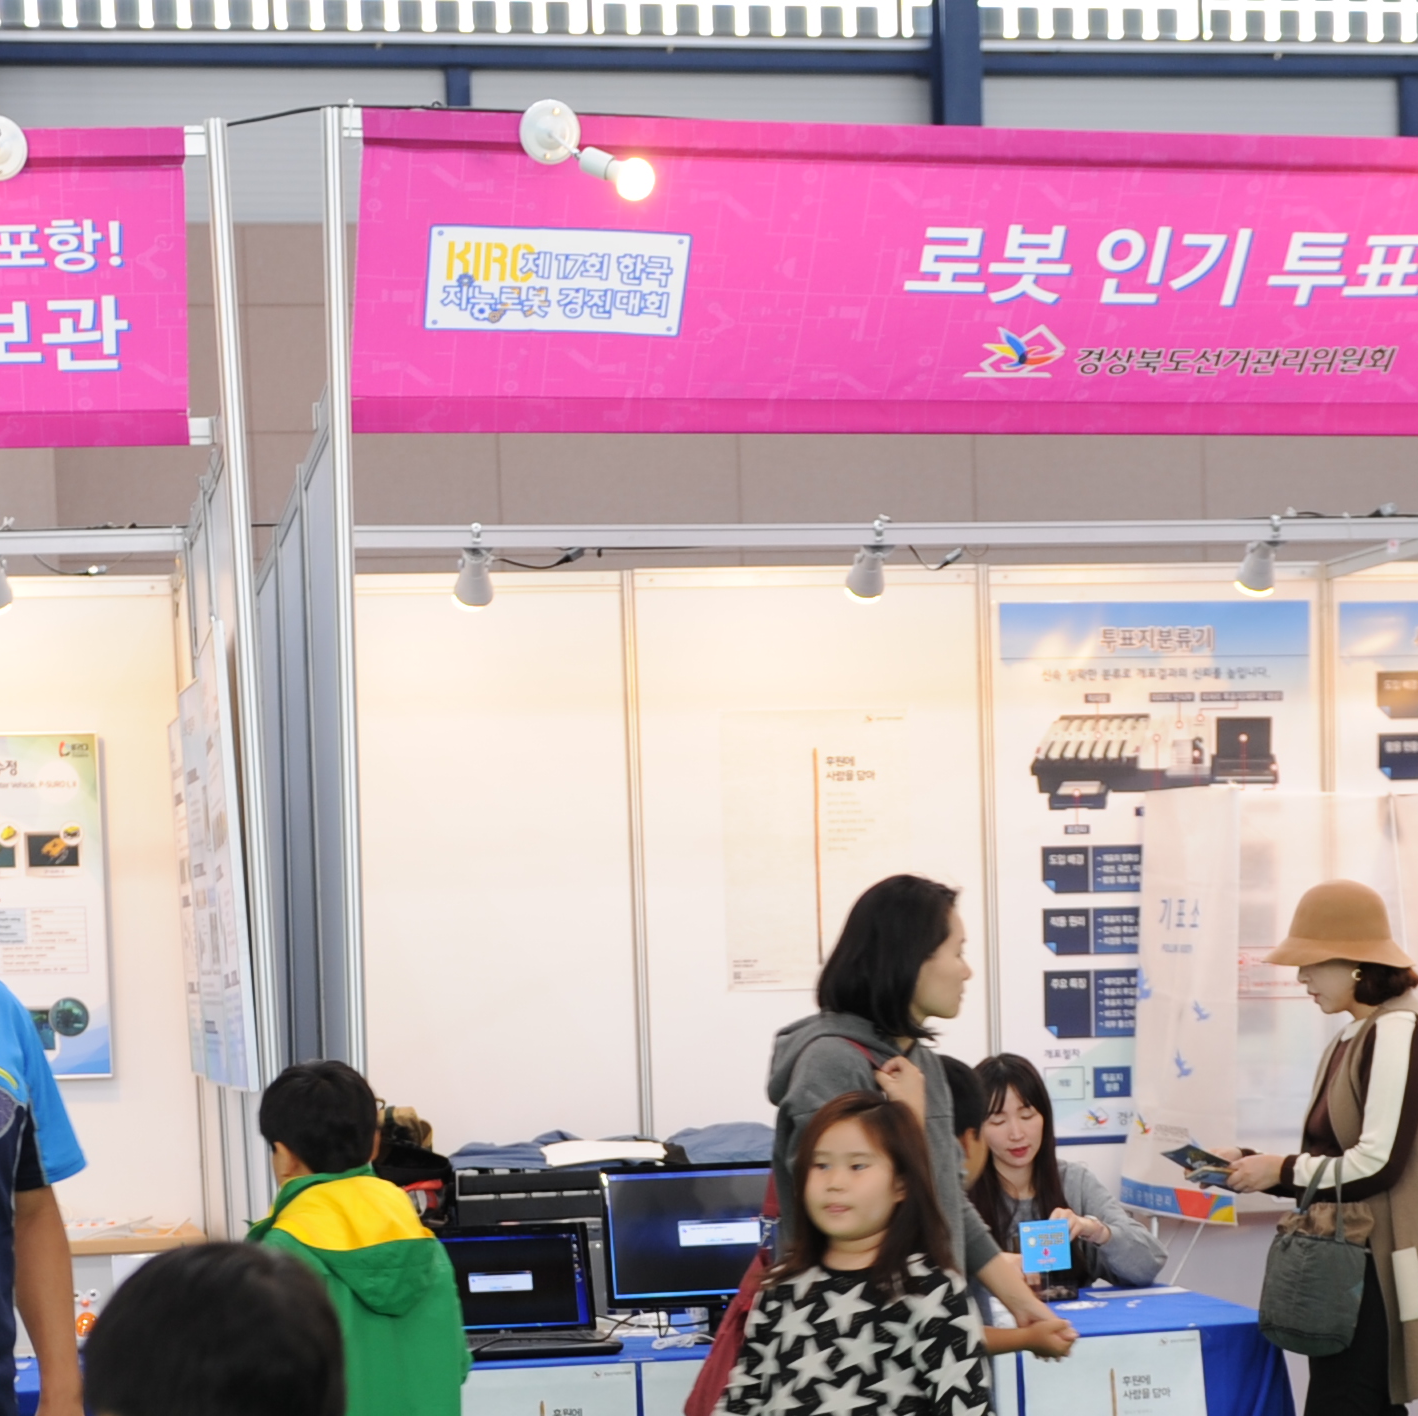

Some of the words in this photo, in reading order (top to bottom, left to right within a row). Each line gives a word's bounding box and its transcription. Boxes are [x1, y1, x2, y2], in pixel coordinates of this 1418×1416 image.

[617, 254, 673, 288] 한국
[904, 223, 1073, 305] 로봇
[1092, 223, 1254, 308] 인기
[441, 285, 551, 322] 지능로봇
[557, 288, 671, 319] 경진대회
[1074, 344, 1399, 377] 경상북도선거관리위원회
[1099, 625, 1216, 651] 투표지분류기
[1152, 1387, 1171, 1398] 담아
